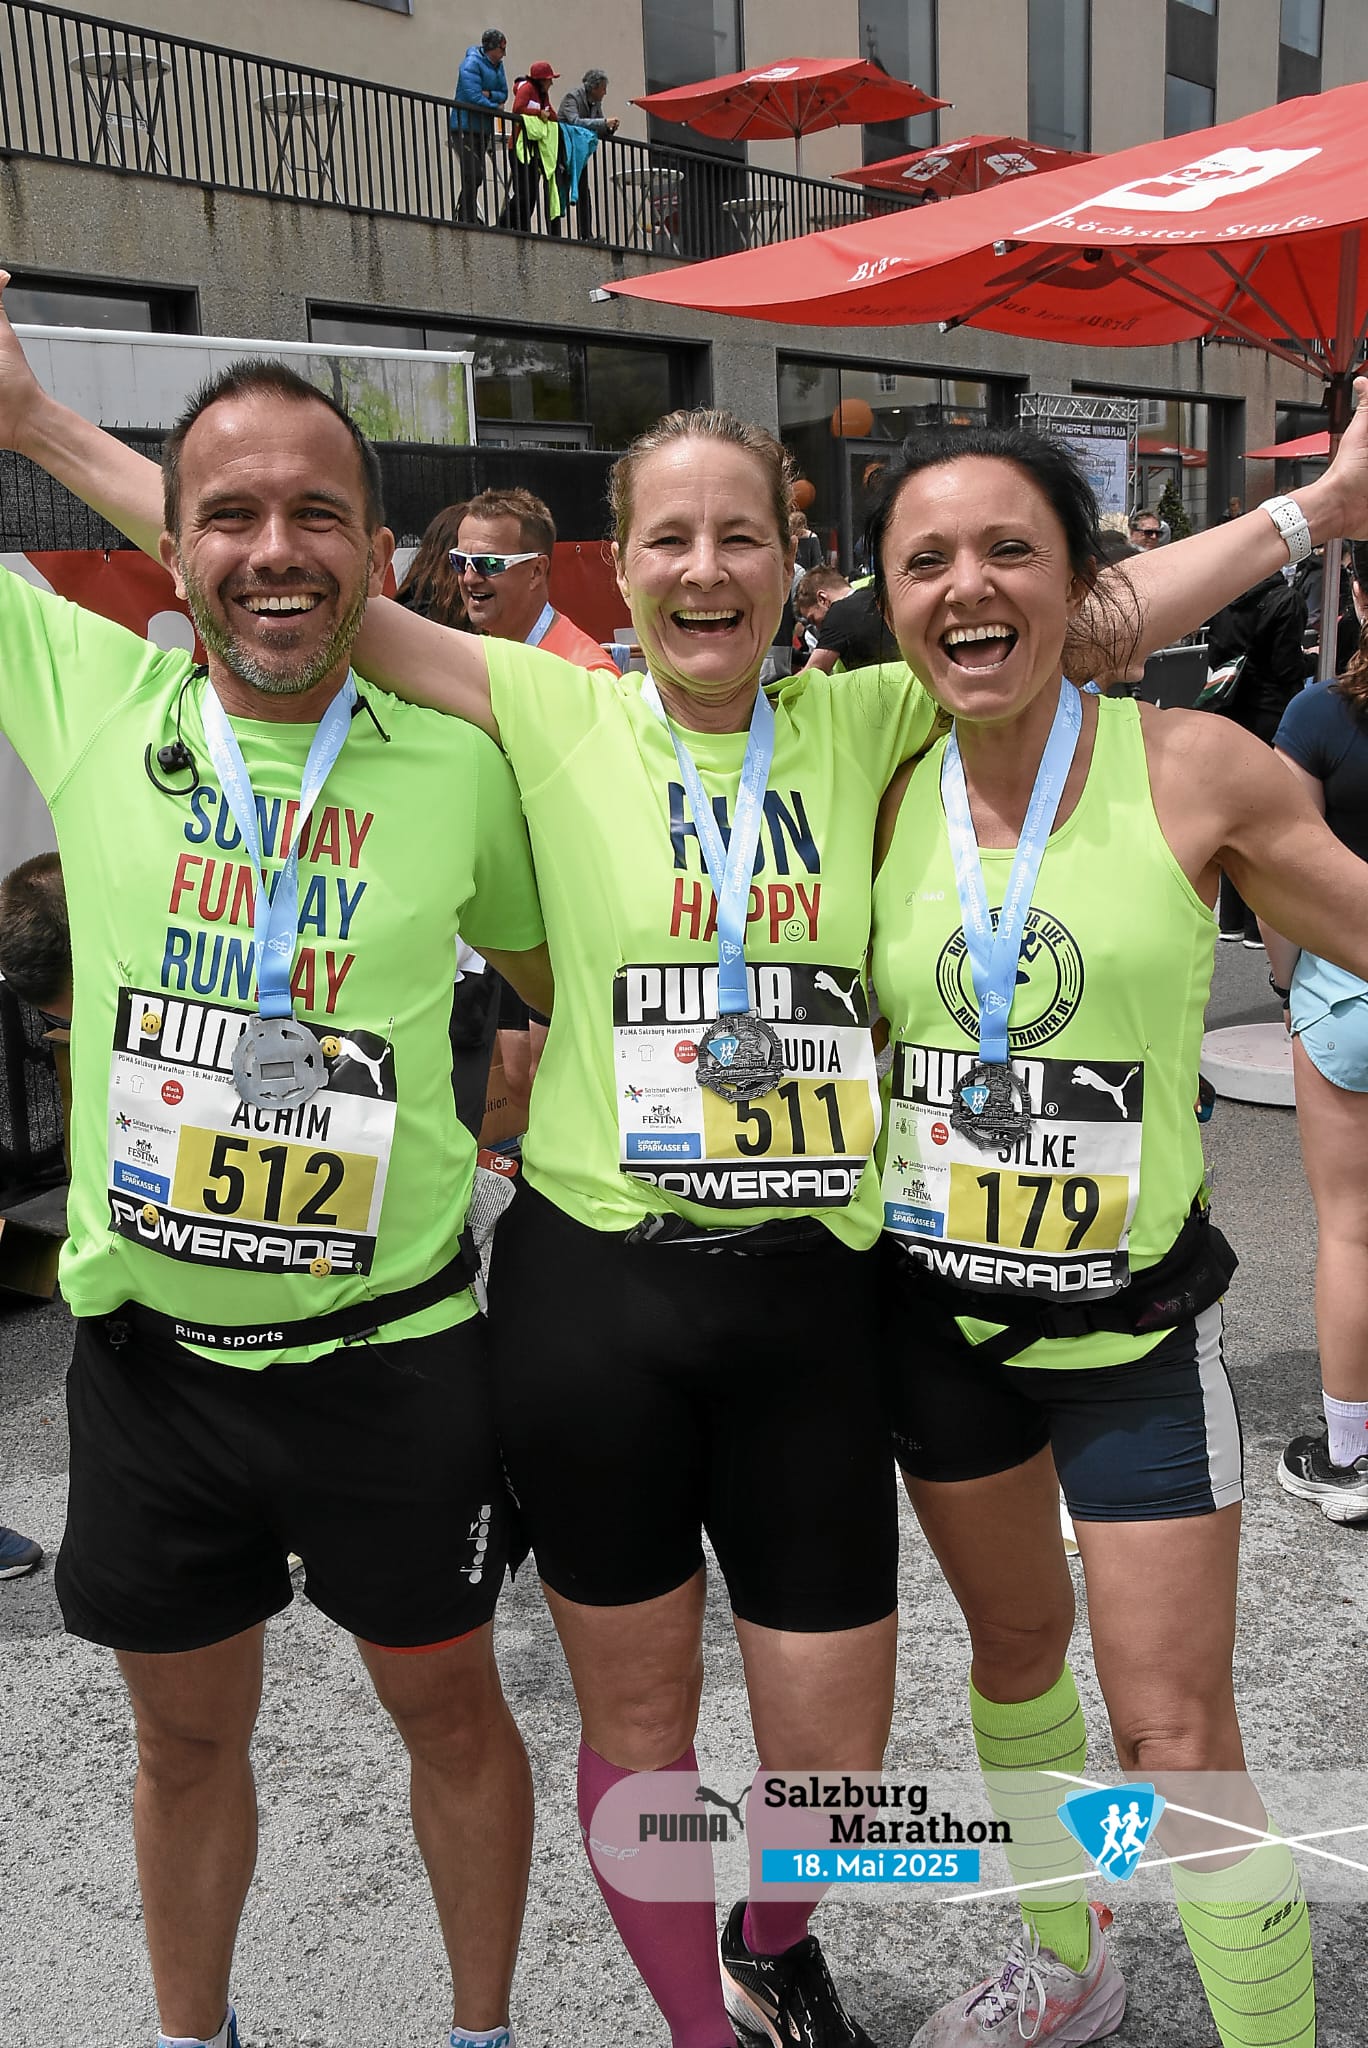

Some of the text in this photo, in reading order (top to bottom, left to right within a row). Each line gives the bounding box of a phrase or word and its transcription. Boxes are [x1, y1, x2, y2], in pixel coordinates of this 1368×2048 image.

[1051, 214, 1325, 239] höchster Stufe.
[183, 785, 375, 869] SUNDAY
[168, 852, 368, 941] FUNAY
[1040, 920, 1067, 948] LIFE
[160, 926, 356, 1015] RUNAY
[126, 993, 251, 1070] PUM
[638, 1028, 665, 1037] Salzburg
[666, 1027, 695, 1035] Marathon
[785, 1037, 842, 1073] UDIA
[903, 1046, 1045, 1117] PUA
[231, 1103, 332, 1142] ACHIM
[642, 1115, 682, 1124] FESTINA
[734, 1081, 846, 1157] 511
[127, 1146, 160, 1165] FESTINA
[637, 1144, 681, 1152] SPARKASSE
[121, 1173, 155, 1191] SPARKASSE
[202, 1134, 345, 1226] 512
[902, 1187, 932, 1202] FESTINA
[892, 1213, 930, 1228] SPARKASSE
[976, 1171, 1100, 1250] 179
[111, 1197, 356, 1268] POWERADE
[895, 1239, 1115, 1292] OWERADE
[175, 1324, 284, 1348] Rima sports
[459, 1504, 492, 1584] diadora
